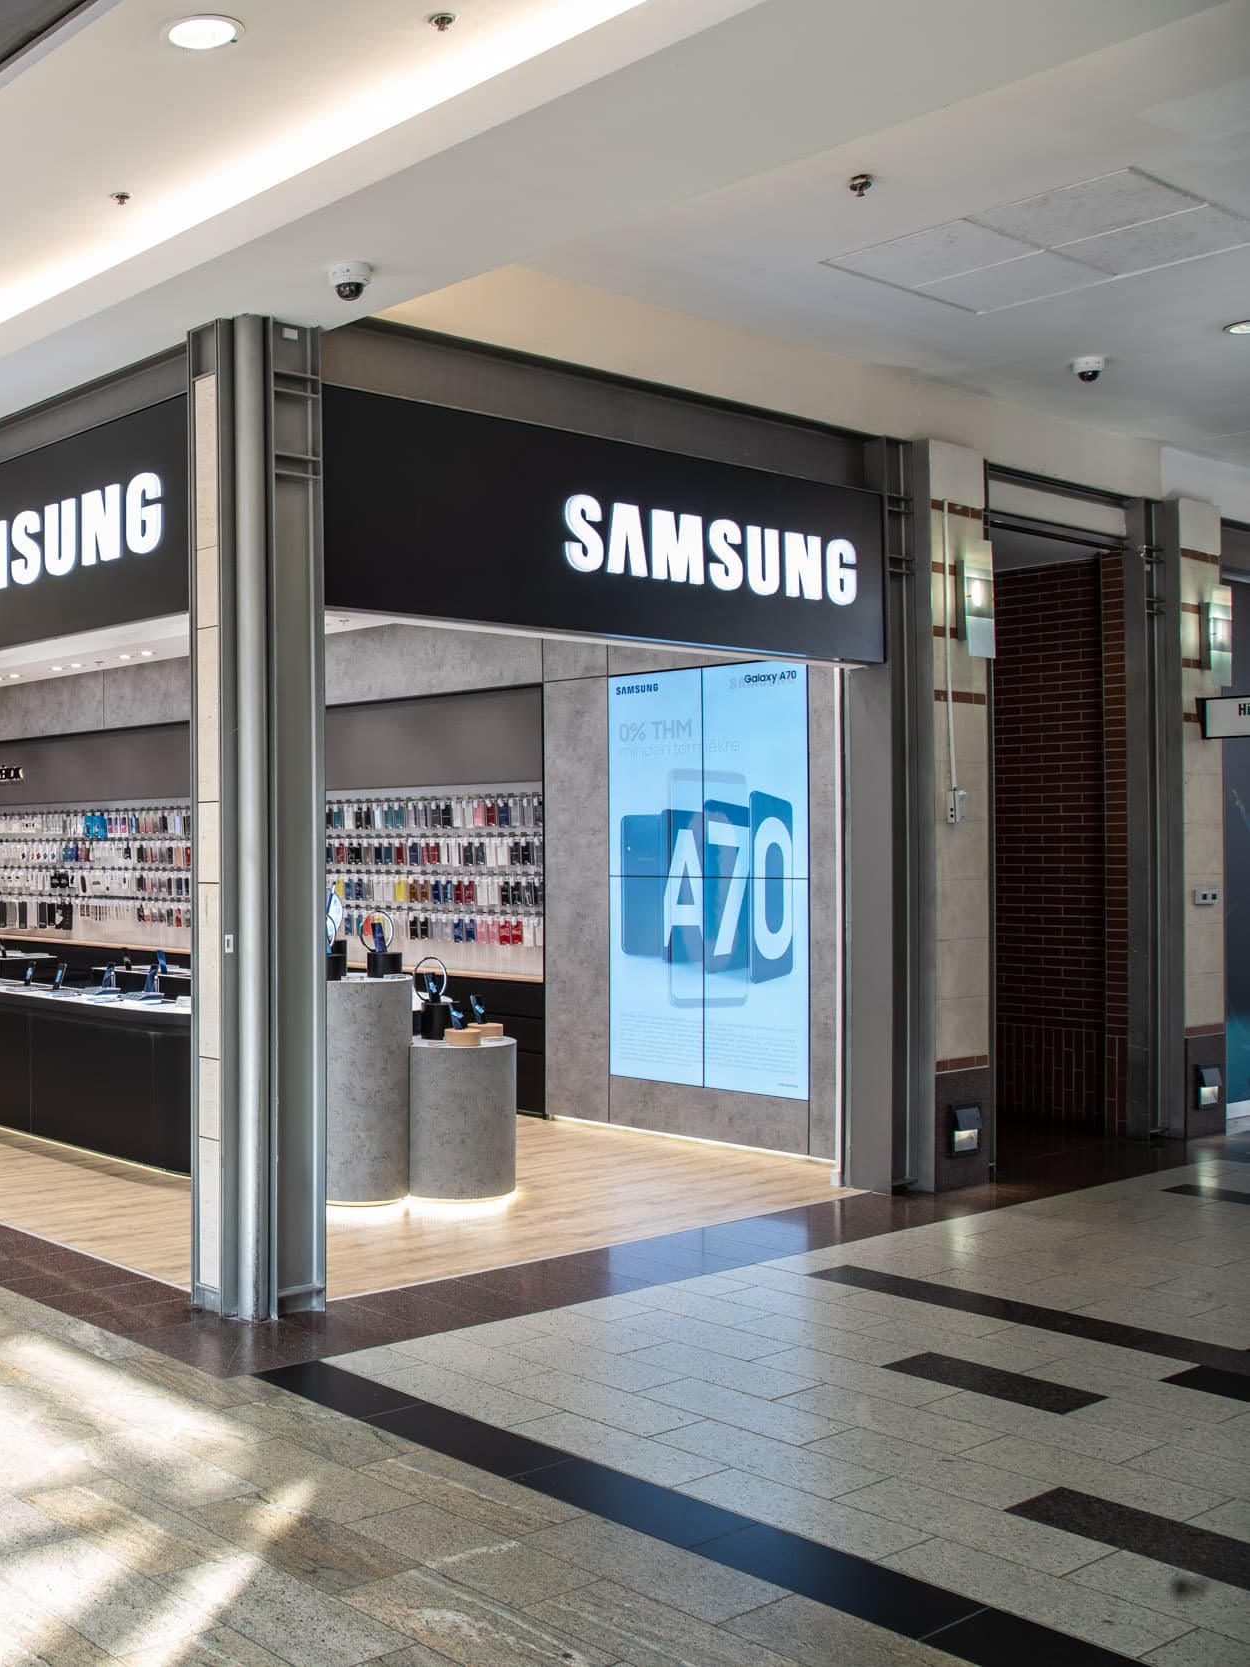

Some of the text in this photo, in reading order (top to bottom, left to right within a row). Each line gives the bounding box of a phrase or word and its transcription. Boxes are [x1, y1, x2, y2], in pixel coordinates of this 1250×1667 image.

[565, 493, 857, 606] SAMSUNG
[744, 674, 777, 684] Galaxy
[780, 670, 797, 680] A70
[616, 683, 659, 696] SAMSUNG
[619, 719, 693, 742] 0% THM
[664, 817, 793, 960] A70
